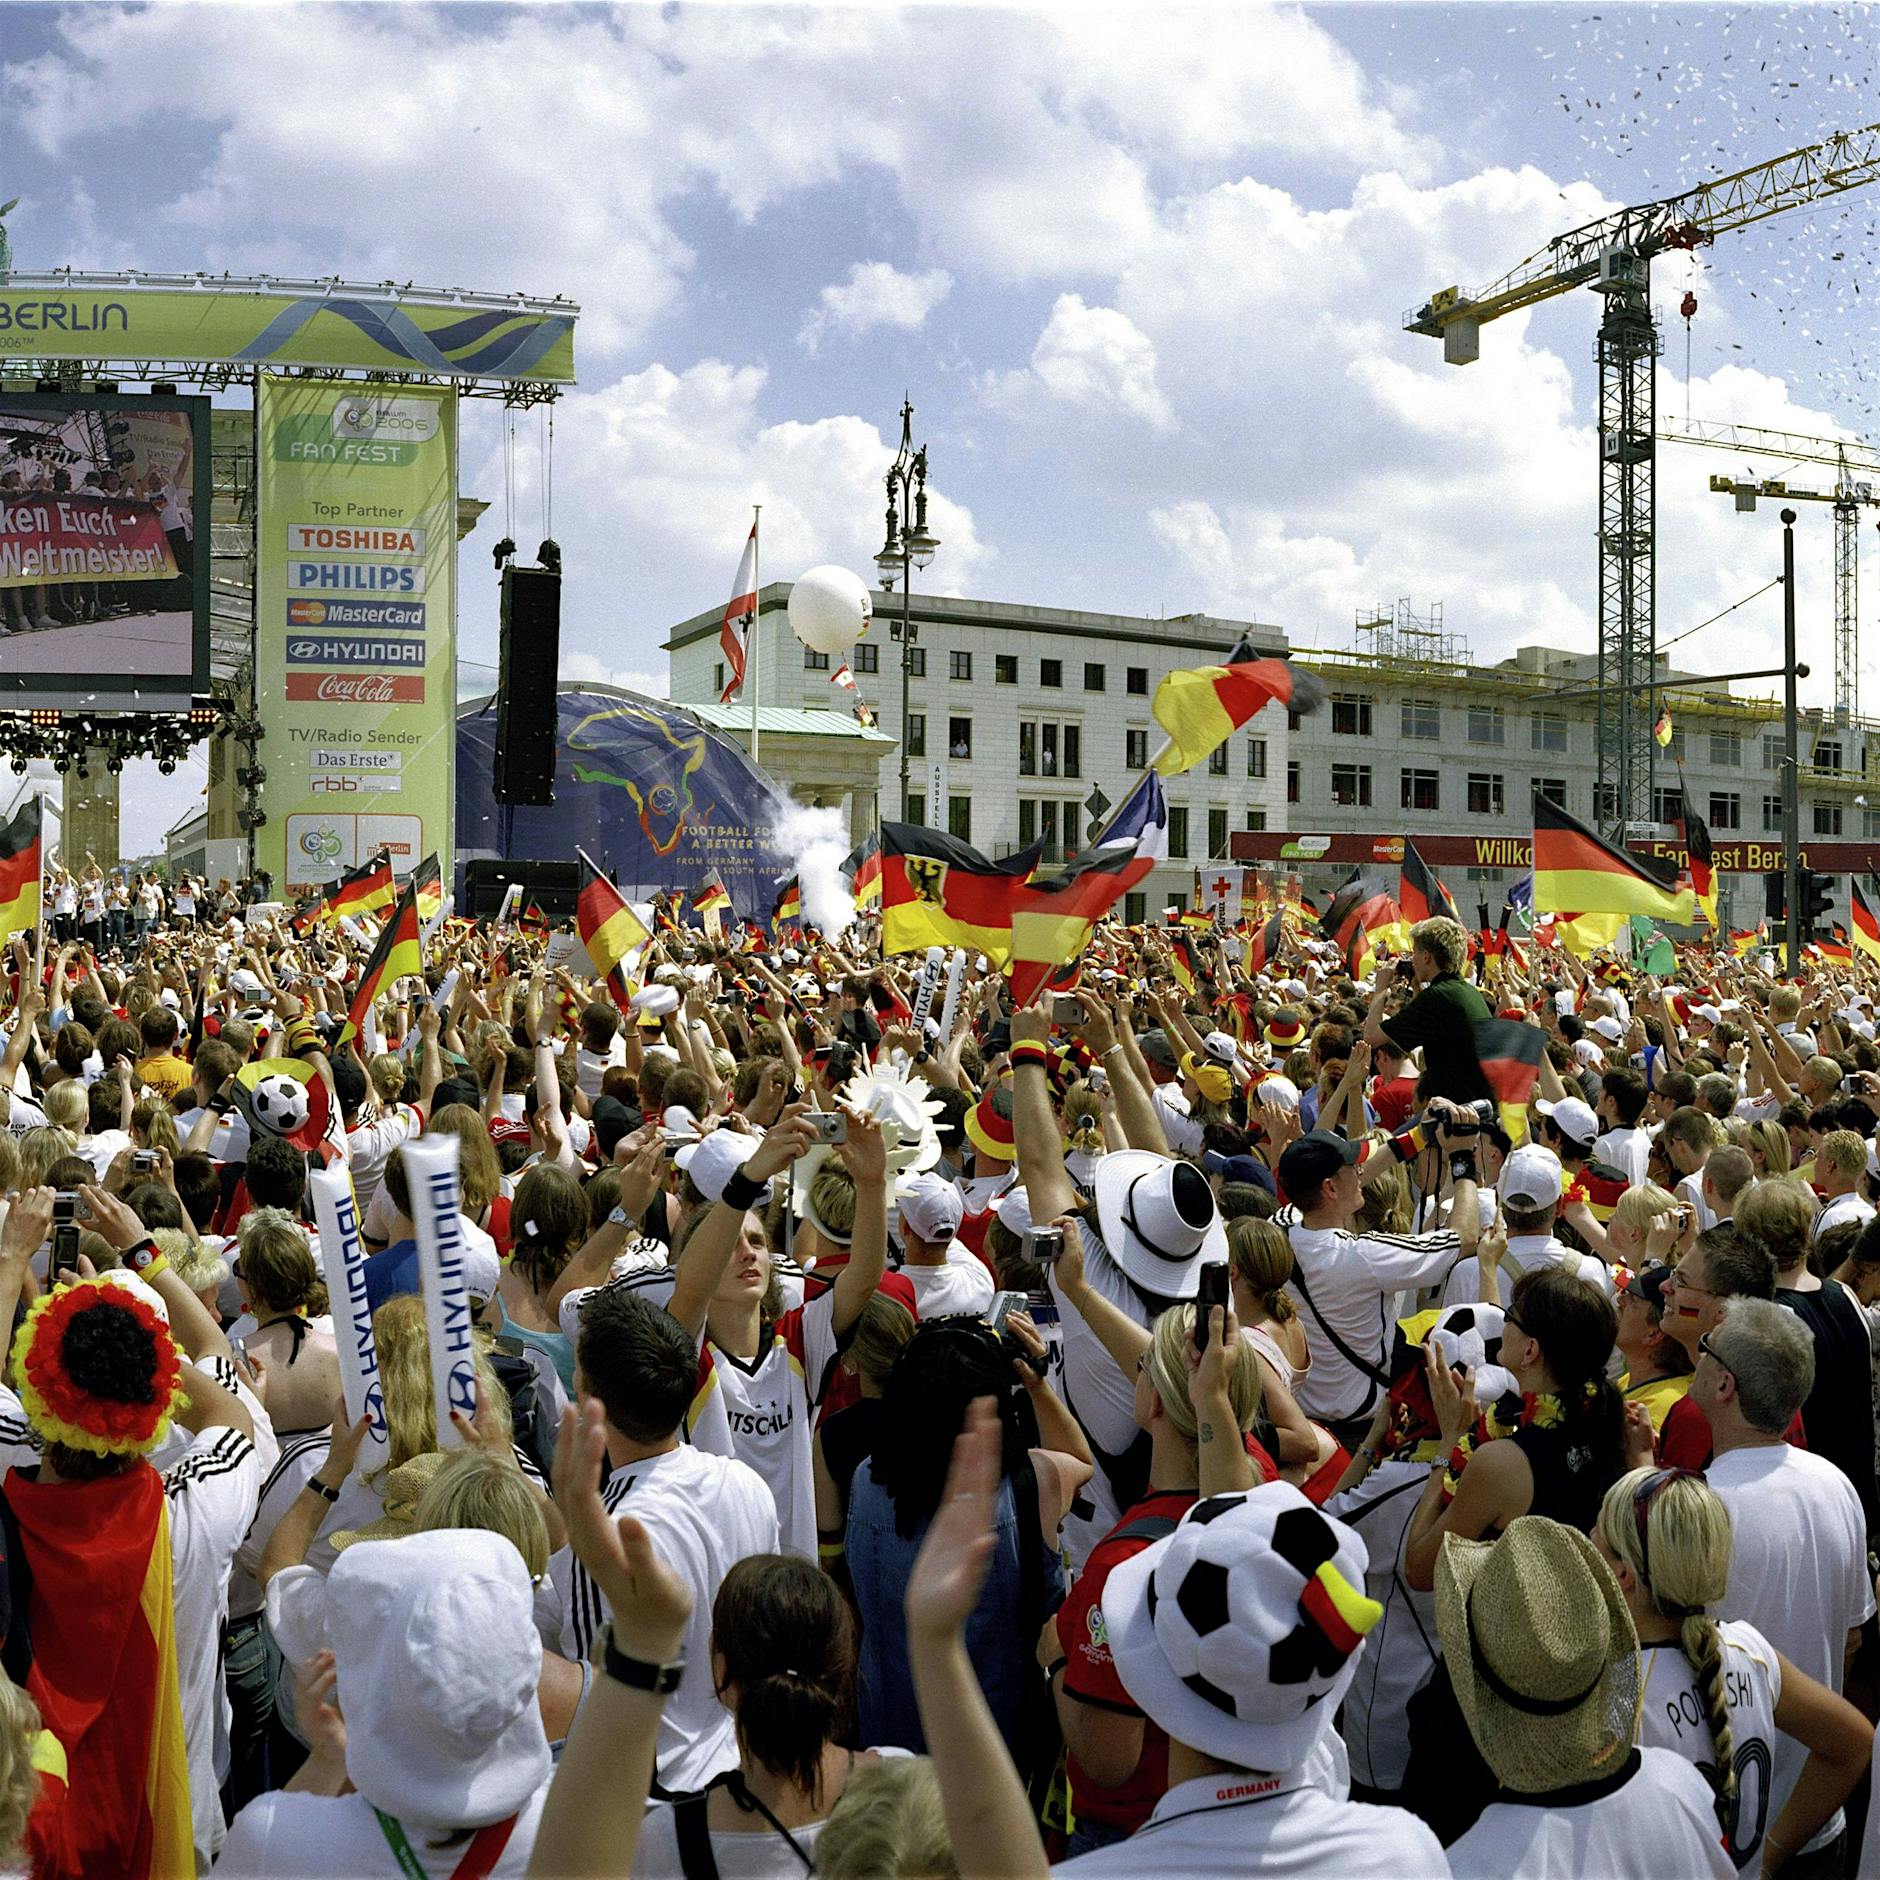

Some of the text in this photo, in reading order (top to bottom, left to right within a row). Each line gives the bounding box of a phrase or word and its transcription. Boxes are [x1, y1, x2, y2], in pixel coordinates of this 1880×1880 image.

[0, 302, 128, 331] BERLIN
[376, 415, 428, 431] 2006
[290, 441, 401, 463] FAN FEST
[0, 502, 50, 533] ken
[56, 501, 118, 536] Euch
[312, 501, 404, 519] Top Partner
[299, 528, 416, 551] TOSHIBA
[299, 563, 415, 591] PHILIPS
[328, 605, 423, 625] MasterCard
[323, 642, 423, 662] HYUNDAI
[288, 728, 422, 744] TV/Radio Sender
[318, 752, 387, 767] Das Erste
[312, 776, 357, 791] rbb
[682, 826, 749, 837] FOOTBALL
[691, 839, 700, 849] A
[706, 838, 754, 850] BETTER
[1475, 839, 1534, 865] Willko
[676, 857, 755, 865] FROM GERMANY
[1711, 846, 1740, 869] est
[723, 866, 754, 874] SOUTH
[1218, 901, 1226, 926] Kreuz
[428, 1172, 472, 1352] HYUNDAI
[334, 1195, 378, 1377] HYUNDAI
[727, 1404, 793, 1436] TSCHLA
[1216, 1776, 1281, 1801] GERMANY
